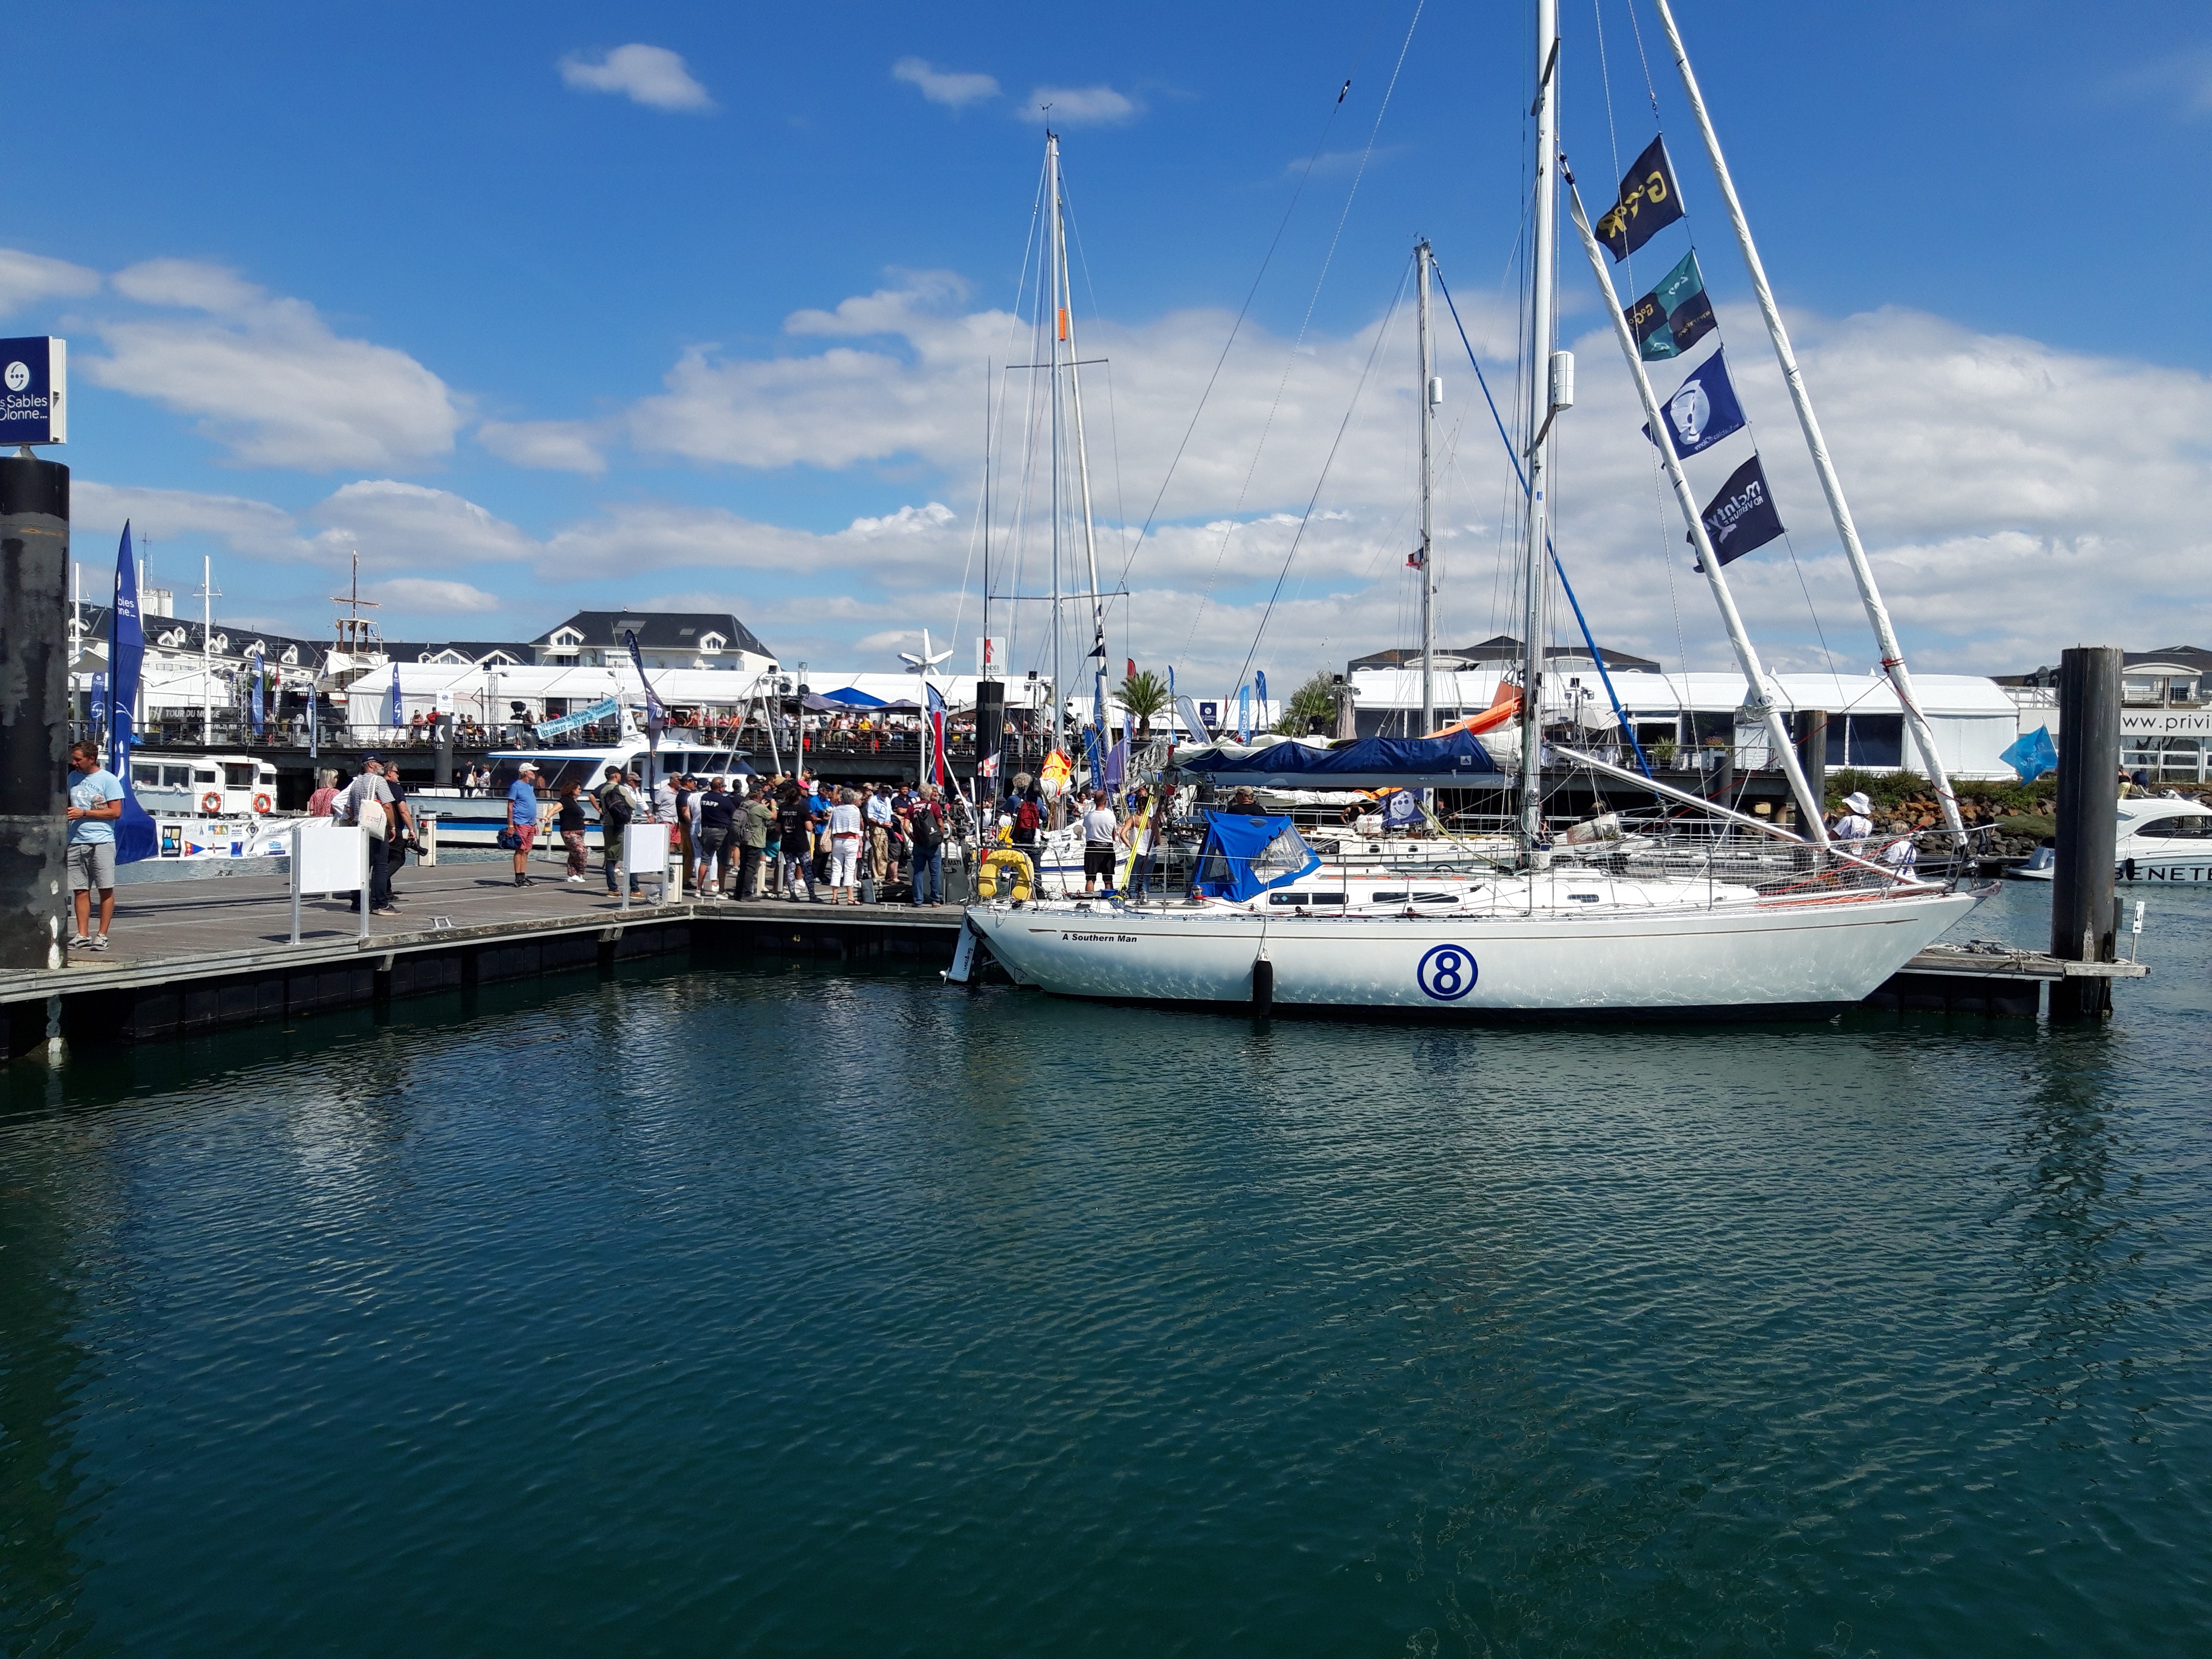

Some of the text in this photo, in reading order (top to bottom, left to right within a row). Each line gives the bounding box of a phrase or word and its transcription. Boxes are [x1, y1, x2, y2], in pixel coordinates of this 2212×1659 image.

[7, 394, 48, 408] Sables
[165, 709, 185, 718] TOUR
[196, 710, 221, 718] MODE
[549, 725, 567, 735] SABLES
[1072, 934, 1114, 942] Southern
[1433, 951, 1461, 994] 8
